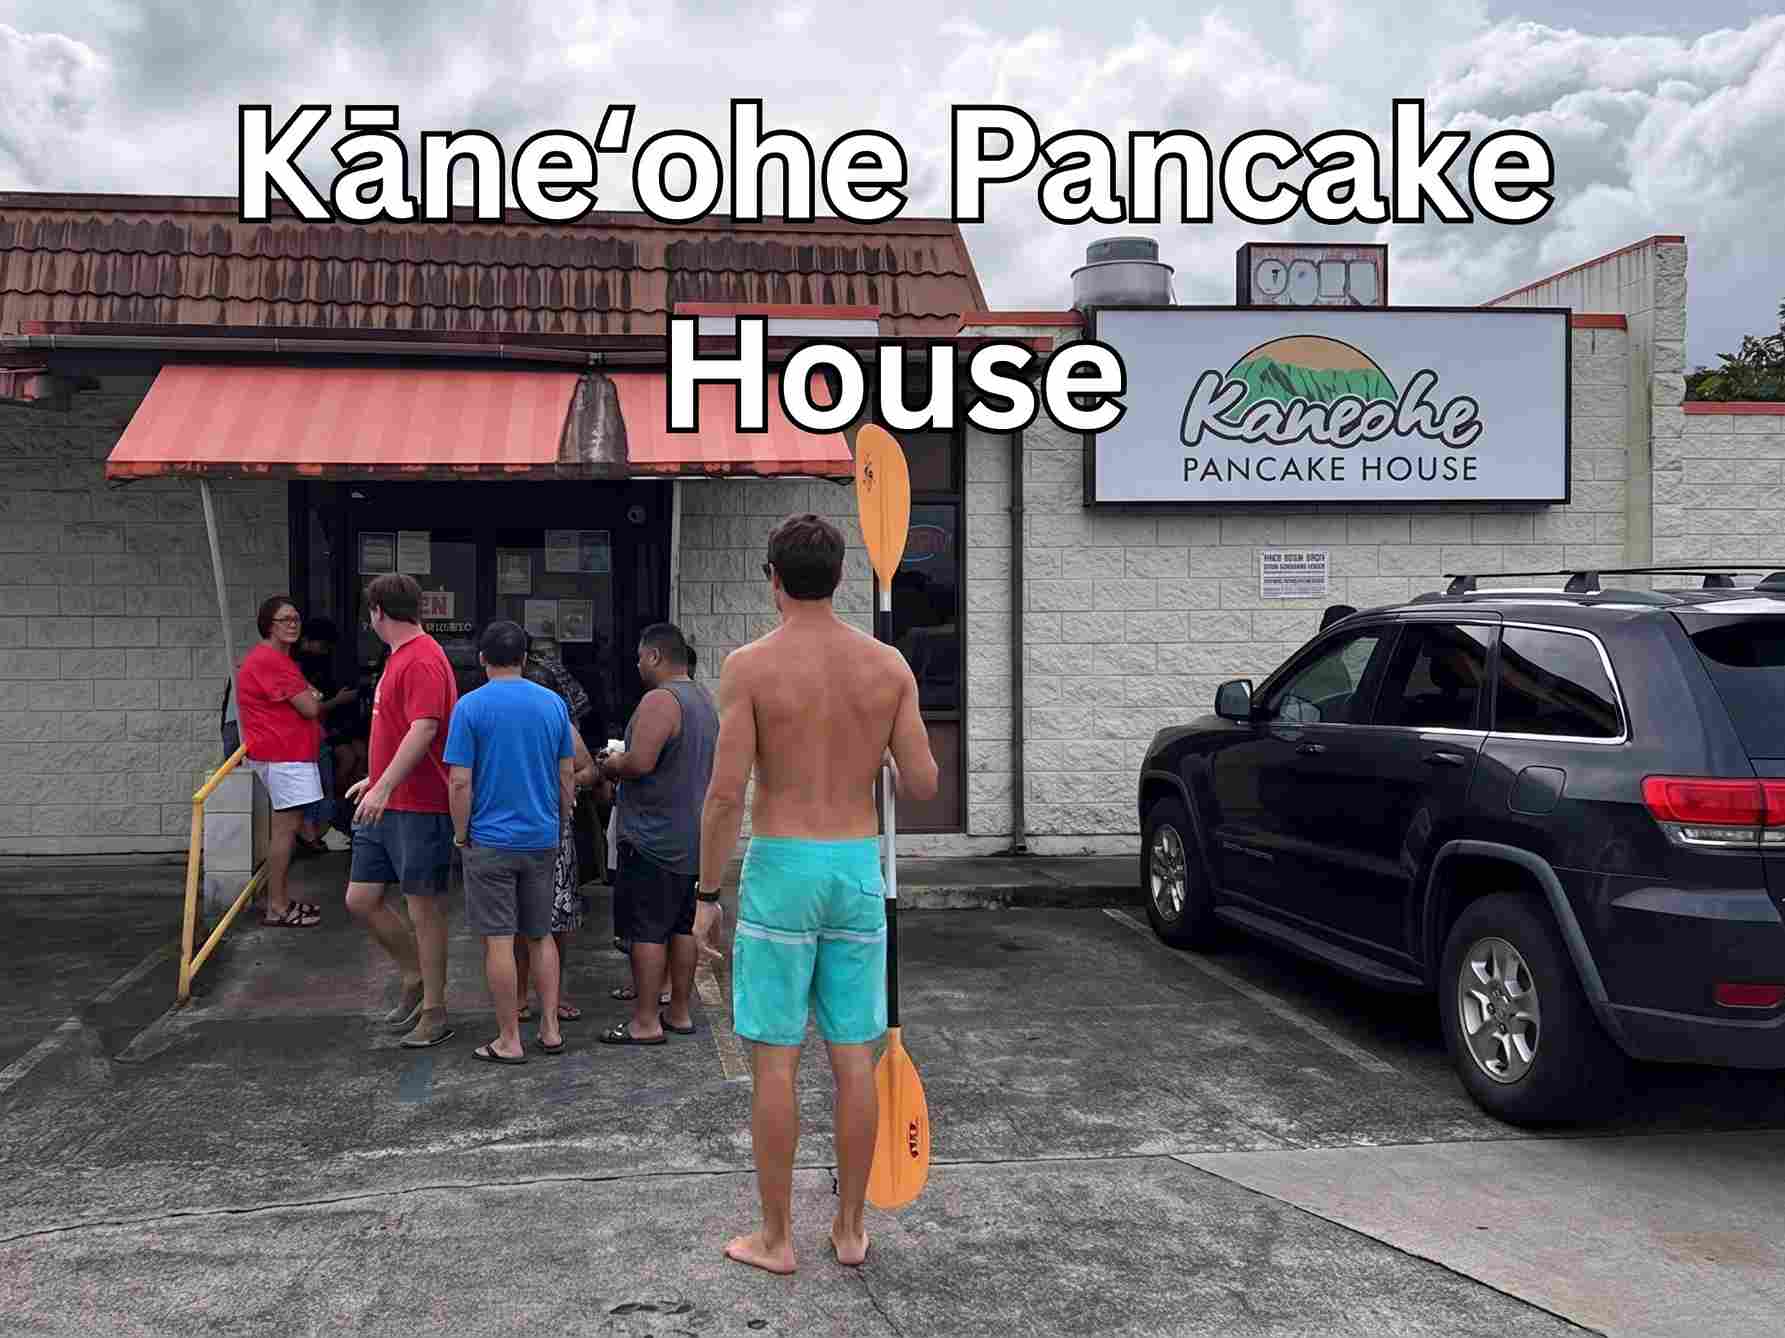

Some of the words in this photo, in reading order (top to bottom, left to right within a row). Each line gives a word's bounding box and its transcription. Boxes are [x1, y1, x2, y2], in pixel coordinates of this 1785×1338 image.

[1180, 369, 1483, 449] Kaneohe
[1184, 456, 1345, 482] PANCAKE
[1362, 456, 1477, 481] HOUSE
